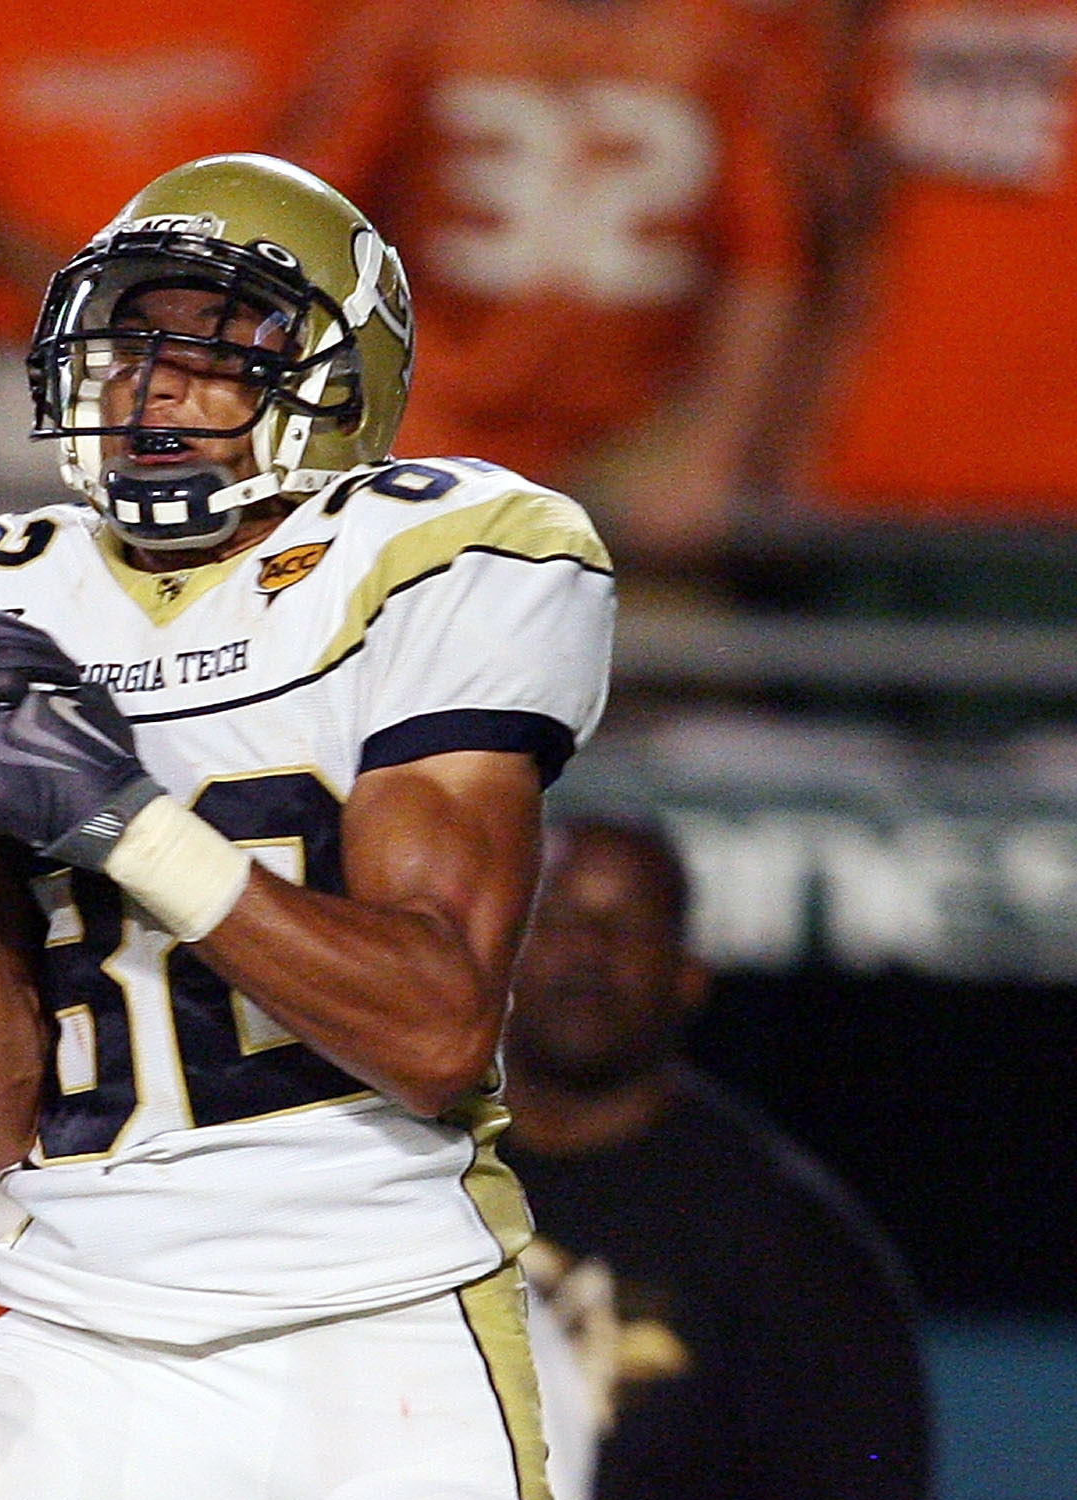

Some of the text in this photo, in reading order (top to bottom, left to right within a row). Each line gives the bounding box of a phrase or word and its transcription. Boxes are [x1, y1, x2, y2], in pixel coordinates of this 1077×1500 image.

[424, 73, 720, 306] 32
[263, 550, 319, 580] ACC
[175, 639, 250, 684] TECH
